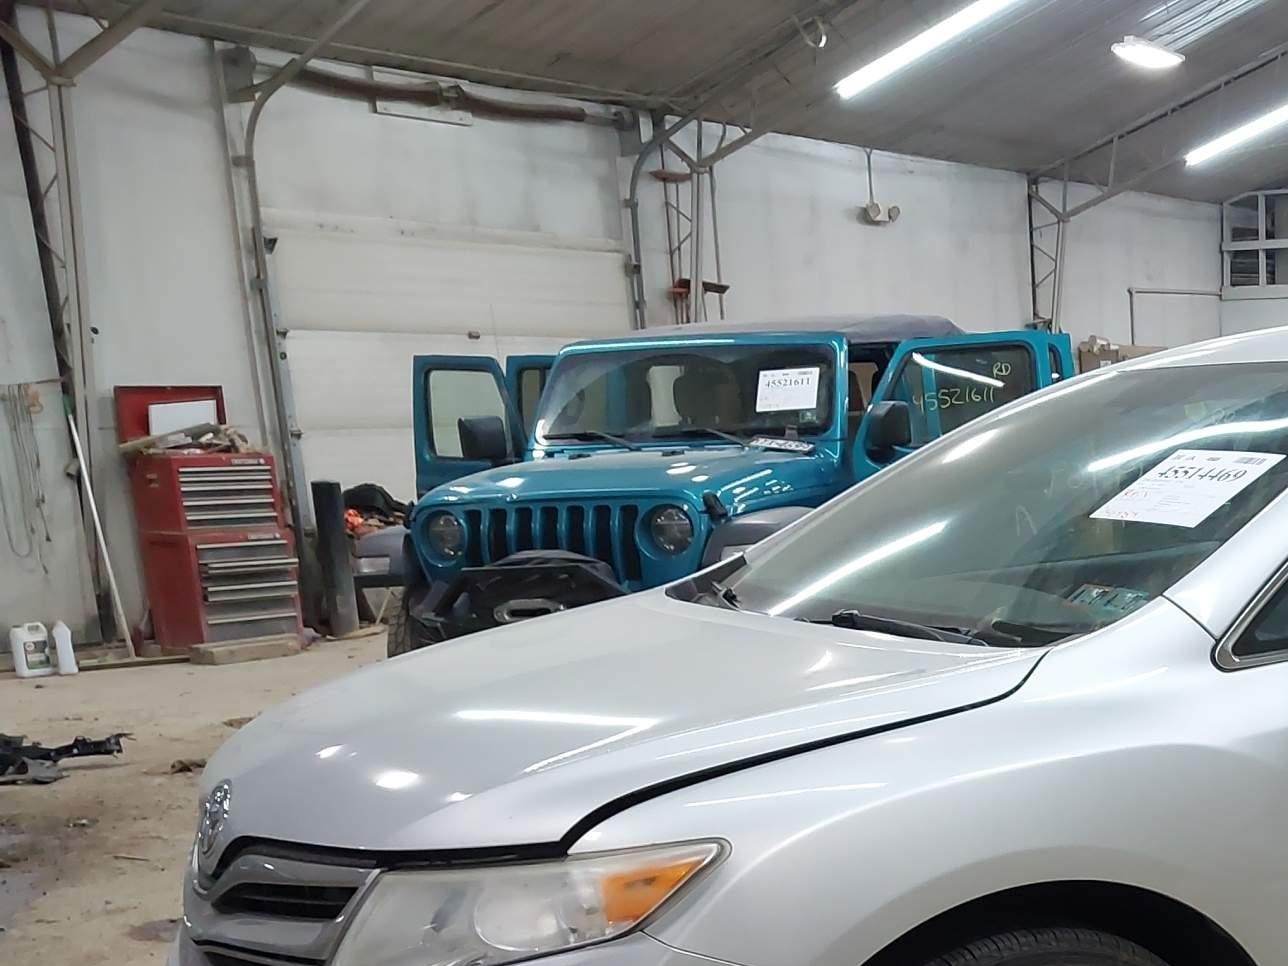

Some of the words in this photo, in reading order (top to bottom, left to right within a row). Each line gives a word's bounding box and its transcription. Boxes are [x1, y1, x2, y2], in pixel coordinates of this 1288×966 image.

[993, 362, 1012, 378] RD
[765, 377, 811, 388] 45521611
[912, 386, 994, 415] 45521611
[1158, 464, 1248, 482] 45514469
